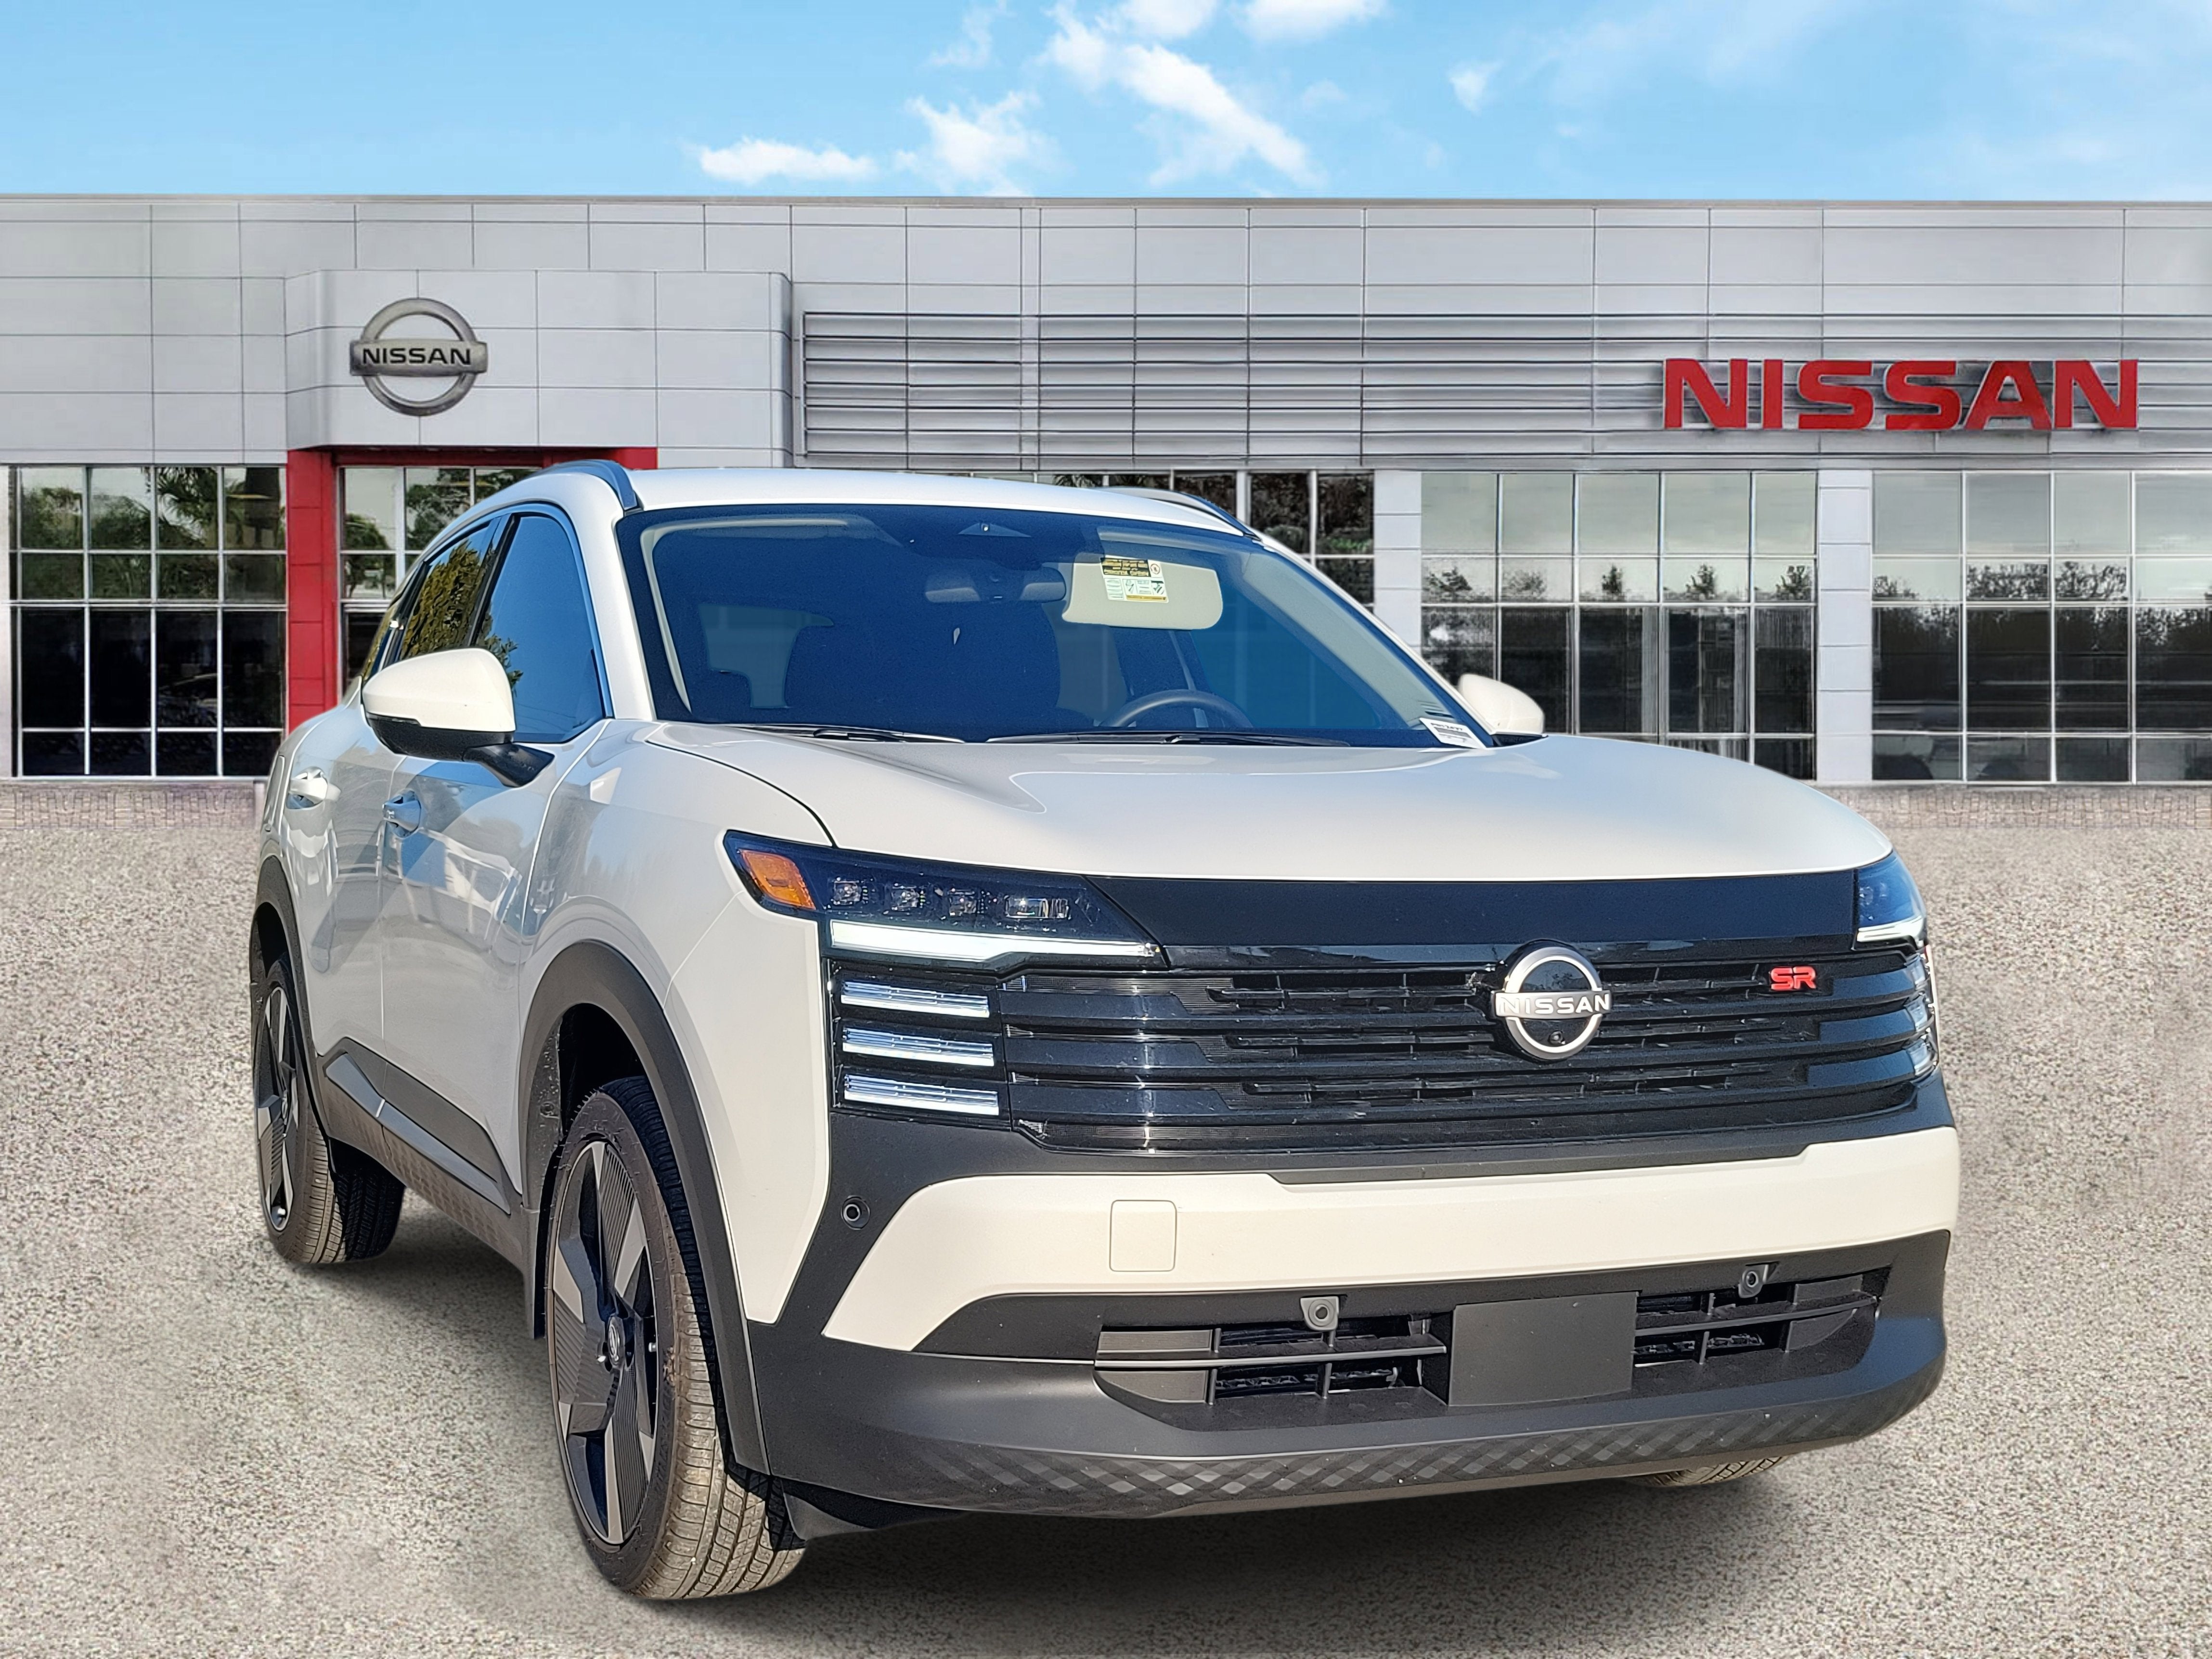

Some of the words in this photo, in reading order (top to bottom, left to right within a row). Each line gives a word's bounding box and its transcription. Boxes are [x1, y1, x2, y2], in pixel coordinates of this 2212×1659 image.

[363, 348, 471, 365] NISSAN
[1664, 358, 2139, 429] NISSAN
[1771, 966, 1816, 990] SR
[1500, 994, 1609, 1014] NISSAN
